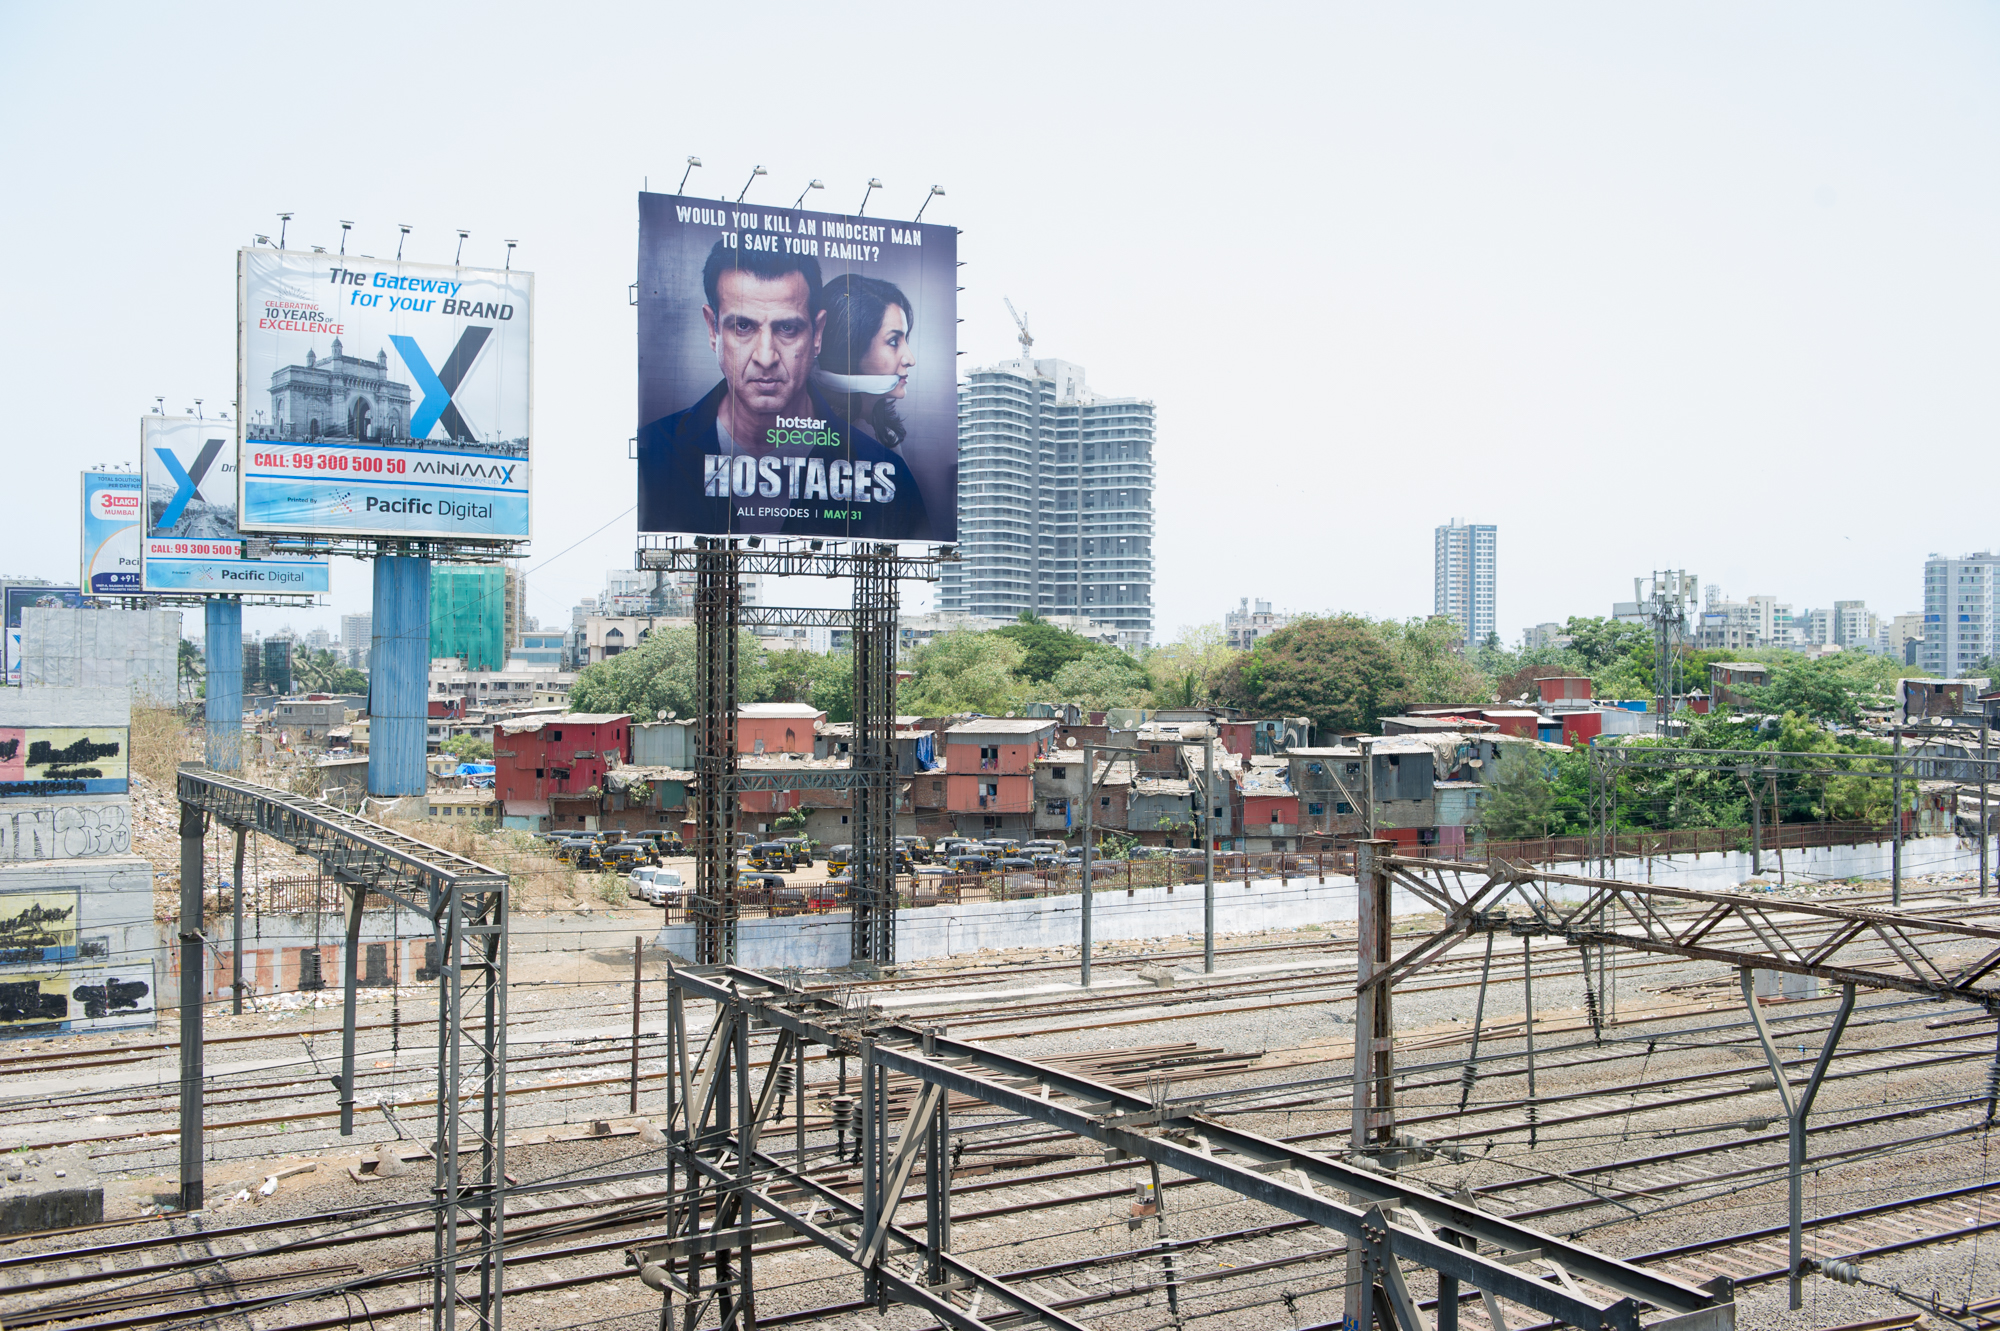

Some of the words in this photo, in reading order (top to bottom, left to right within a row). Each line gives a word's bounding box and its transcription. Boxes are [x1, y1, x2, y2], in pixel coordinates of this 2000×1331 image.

[676, 205, 725, 227] WOULD
[732, 210, 758, 229] YOU
[764, 214, 792, 233] KILL
[798, 218, 816, 236] AN
[822, 220, 885, 243] INNOCENT
[891, 227, 922, 246] MAN
[721, 232, 738, 248] TO
[744, 234, 779, 253] SAVE
[784, 237, 819, 257] YOUR
[824, 242, 880, 262] FAMILY?
[329, 267, 367, 287] The
[372, 271, 463, 298] Gateway
[265, 300, 319, 311] CELEBRATING
[265, 307, 280, 319] 10
[281, 309, 325, 322] YEARS
[350, 290, 382, 308] for
[389, 295, 436, 313] your
[442, 298, 514, 321] BRAND
[259, 318, 345, 335] EXCELLENCE
[775, 415, 827, 430] hotstar
[766, 427, 841, 448] specials
[254, 452, 289, 468] CALL:
[292, 453, 314, 469] 99
[317, 454, 348, 471] 300
[352, 456, 383, 473] 500
[387, 457, 406, 474] 50
[703, 454, 896, 504] HOSTAGES
[101, 493, 113, 508] 3
[115, 497, 137, 506] LAKH
[365, 496, 433, 515] Pacific
[438, 499, 493, 521] Digital
[737, 506, 756, 517] ALL
[758, 506, 810, 519] EPISODES
[823, 508, 847, 520] MAY
[850, 510, 863, 521] 31
[151, 543, 173, 554] CALL:
[174, 543, 188, 554] 99
[190, 544, 210, 555] 300
[212, 544, 232, 555] 500
[221, 569, 265, 581] Pacific
[268, 571, 304, 584] Digital
